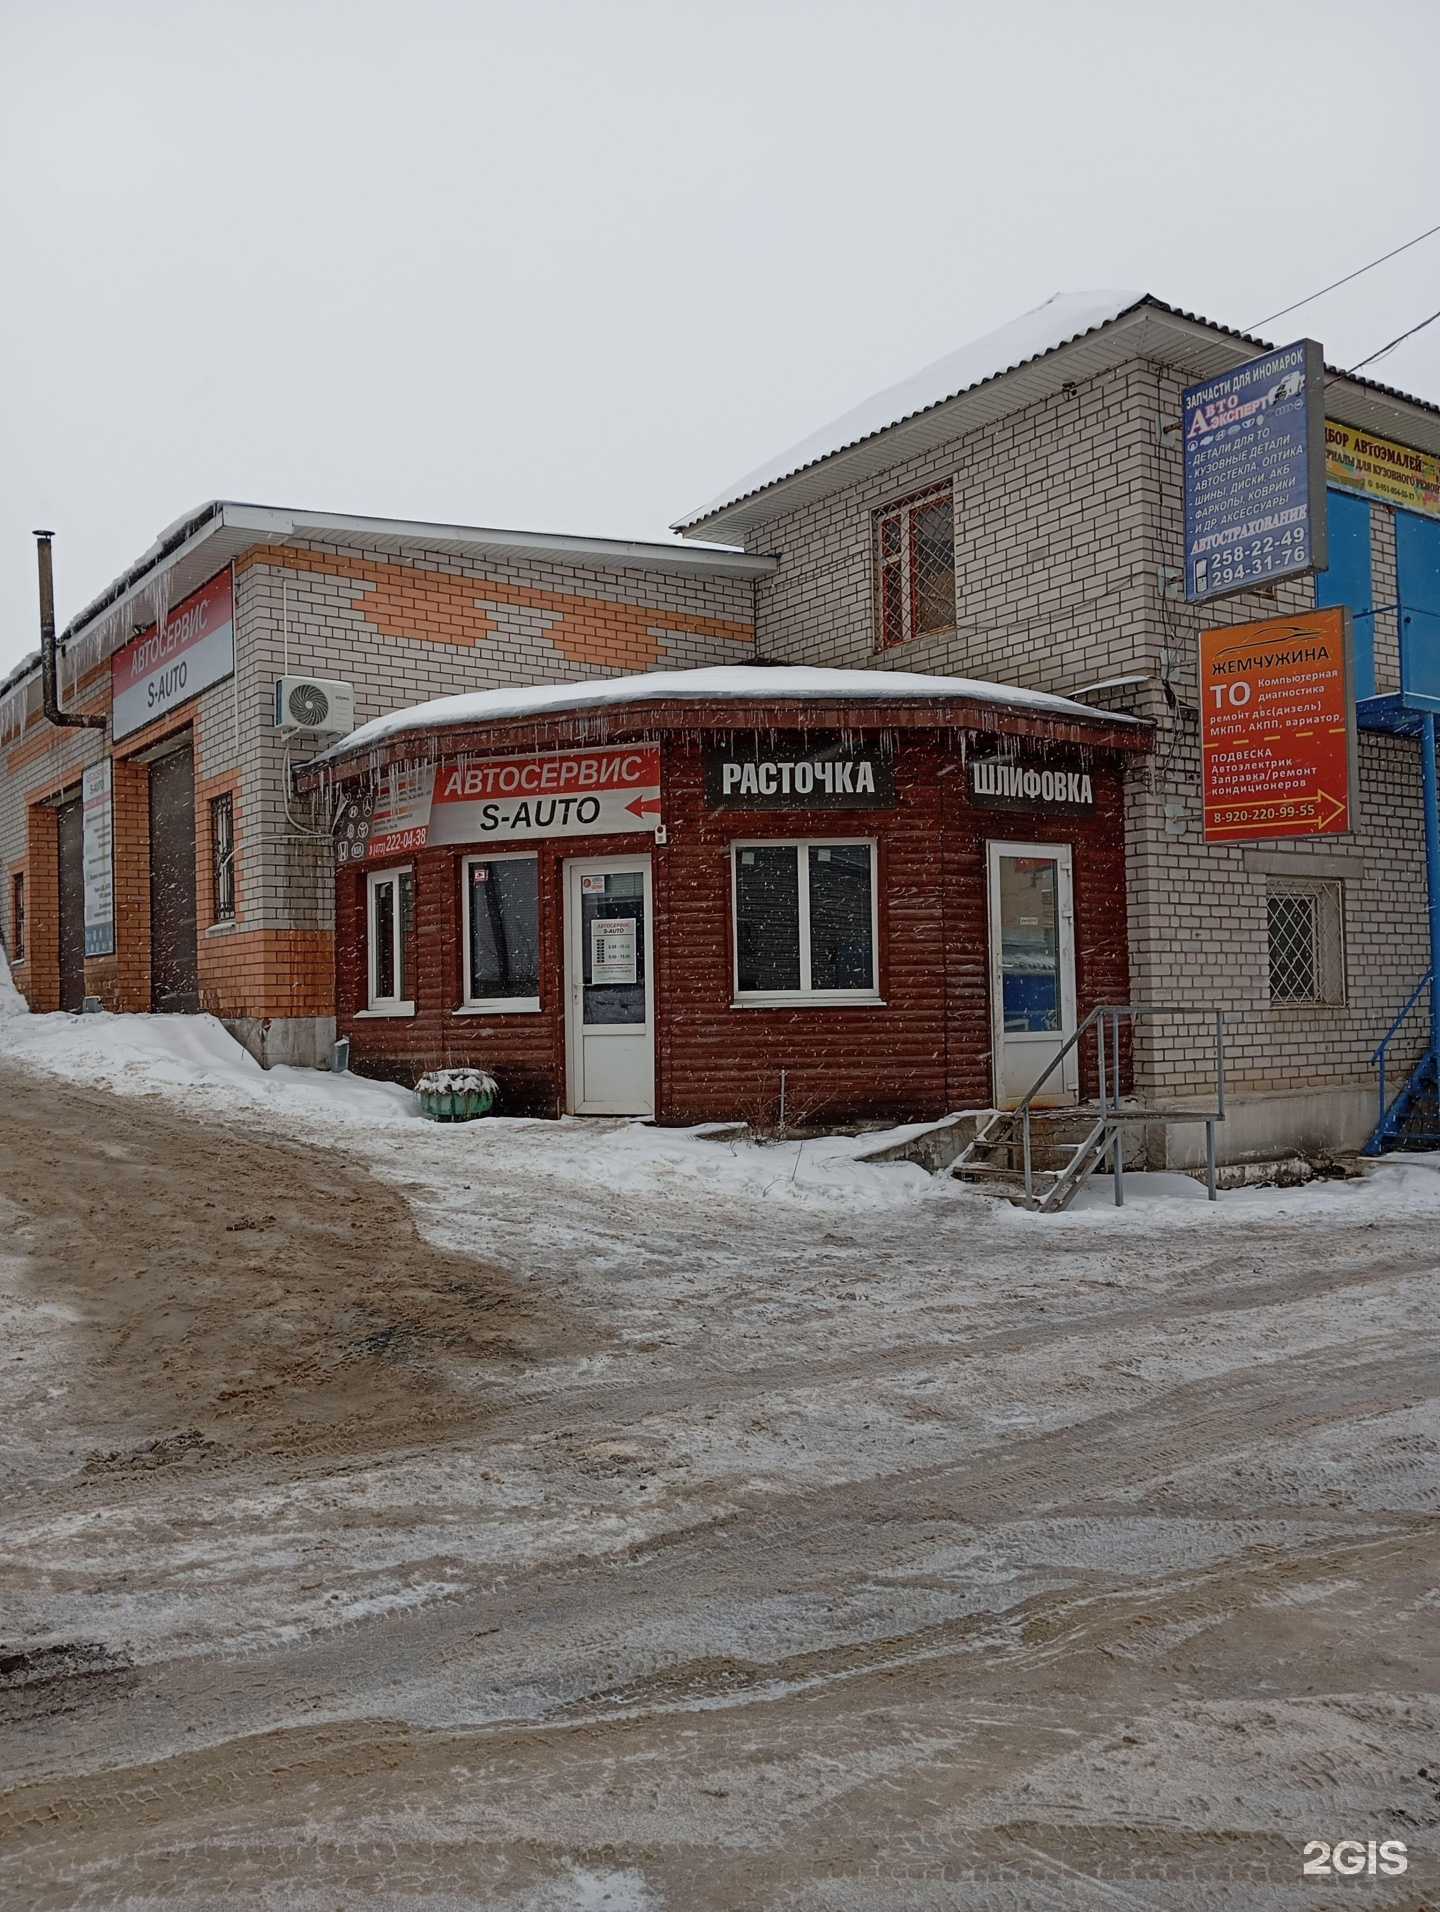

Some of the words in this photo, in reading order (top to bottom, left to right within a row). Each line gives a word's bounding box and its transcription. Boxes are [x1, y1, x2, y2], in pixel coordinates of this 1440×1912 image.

[1186, 380, 1231, 410] ЗАПЧАСТИ
[1233, 371, 1251, 391] ДЛЯ
[1253, 349, 1304, 382] ИНОМАРОК
[1210, 396, 1268, 430] ЭКСПЕРТ
[1193, 443, 1232, 466] ДЕТАЛИ
[1233, 434, 1254, 452] ДЛЯ
[1256, 428, 1271, 441] ТО
[1194, 450, 1248, 478] КУЗОВНЫЕ
[1249, 434, 1291, 460] ДЕТАЛИ
[1262, 445, 1303, 467] ОПТИКА
[1354, 438, 1423, 473] АВТОЭМАЛЕЙ
[1270, 464, 1290, 480] АКБ
[1248, 477, 1296, 501] КОВРИКИ
[1195, 523, 1202, 534] И
[1221, 494, 1289, 525] АКСЕССУАРЫ
[1211, 527, 1305, 569] 258-22-49
[1212, 546, 1306, 587] 294-31-76
[130, 601, 209, 678] АВТОСЕРВИС
[1211, 646, 1330, 676] ЖЕМЧУЖИНА
[148, 661, 188, 708] S-AUTO
[1258, 670, 1339, 688] Компьютерная
[1258, 685, 1326, 703] диагностика
[1209, 681, 1251, 709] ТО
[1210, 711, 1250, 725] ремонт
[1210, 725, 1246, 737] МКПП,
[1248, 720, 1283, 732] АКПП,
[1211, 748, 1273, 763] ПОДВЕСКА
[1211, 758, 1293, 774] Автоэлектрик
[444, 755, 642, 797] АВТОСЕРВИС
[722, 761, 875, 795] РАСТОЧКА
[973, 763, 1093, 804] ШЛИФОВКА
[1211, 767, 1317, 785] Заправка/ремонт
[1211, 779, 1306, 796] кондиционеров
[480, 797, 601, 831] S-AUTO
[1214, 805, 1316, 824] 8-920-220-99-55
[386, 828, 426, 852] 222-04-38
